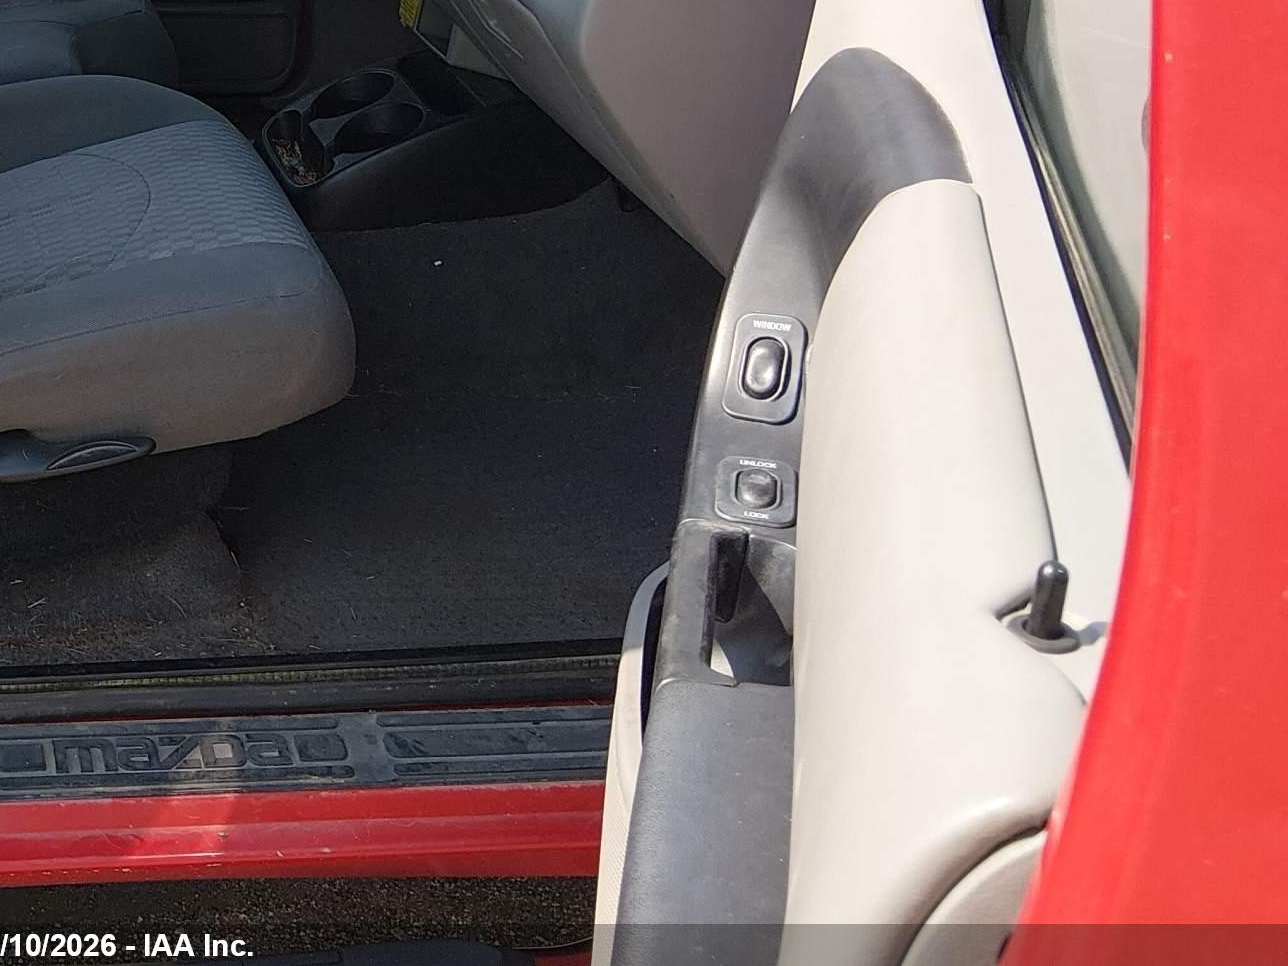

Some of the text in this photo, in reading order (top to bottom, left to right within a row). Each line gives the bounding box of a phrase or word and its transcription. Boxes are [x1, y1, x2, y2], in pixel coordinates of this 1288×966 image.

[752, 319, 792, 332] WINDOW
[739, 459, 777, 469] UNLOCK
[743, 510, 769, 520] LOCK
